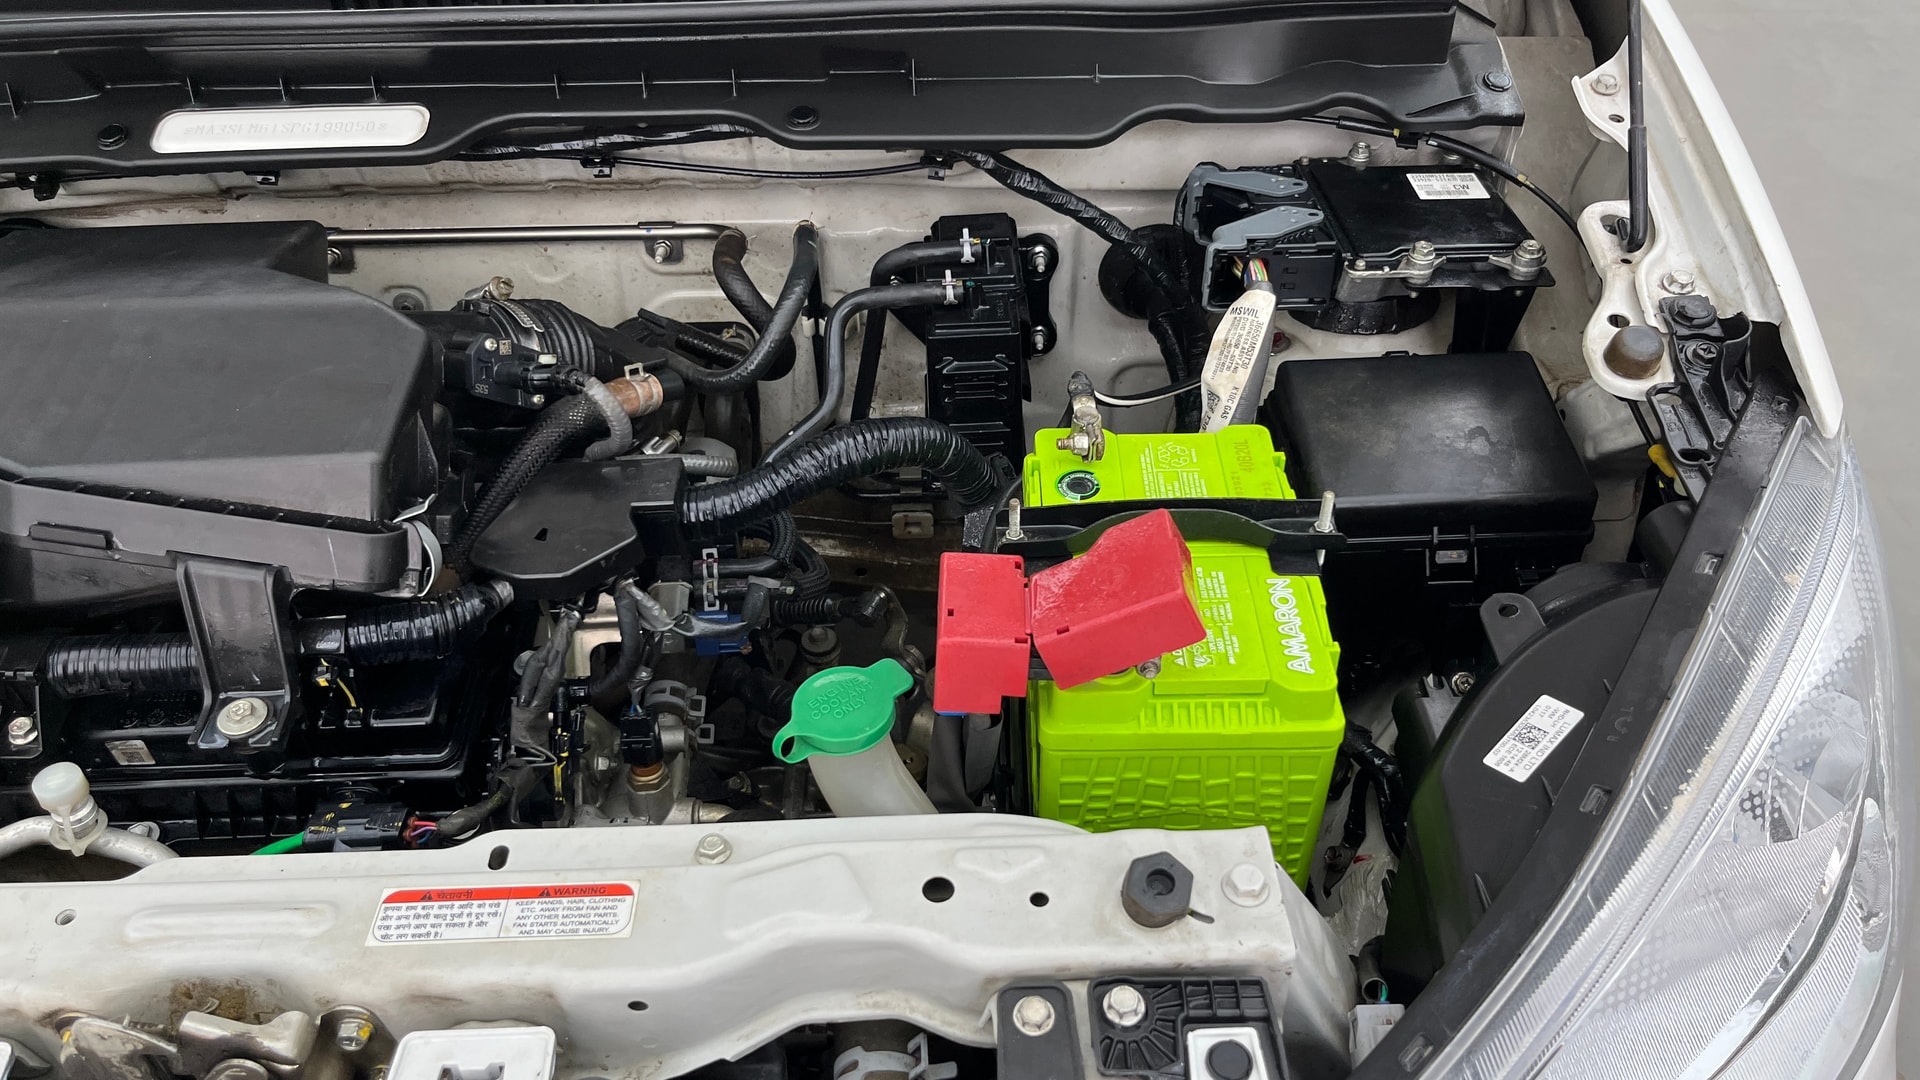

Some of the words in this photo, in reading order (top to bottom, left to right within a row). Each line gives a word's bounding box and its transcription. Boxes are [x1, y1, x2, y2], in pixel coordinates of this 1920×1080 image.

[1230, 306, 1260, 318] MSWIL
[1226, 386, 1240, 405] K10C
[1221, 405, 1232, 420] GAS
[1265, 577, 1316, 675] AMARON
[808, 676, 861, 709] ENGINE
[811, 680, 873, 720] COOLANT
[833, 696, 867, 718] ONLY
[1548, 722, 1571, 746] LUMAX
[1535, 744, 1551, 757] IND
[1523, 756, 1540, 771] LTD
[437, 889, 473, 899] चेतावनी
[554, 887, 607, 895] WARNING
[383, 905, 402, 914] कृपया
[458, 901, 474, 909] आदि
[413, 912, 431, 920] किसी
[475, 912, 484, 920] दूर
[394, 922, 411, 930] अपने
[560, 919, 619, 927] AUTOMATICALLY
[381, 932, 393, 940] चोट
[411, 931, 431, 939] सकती
